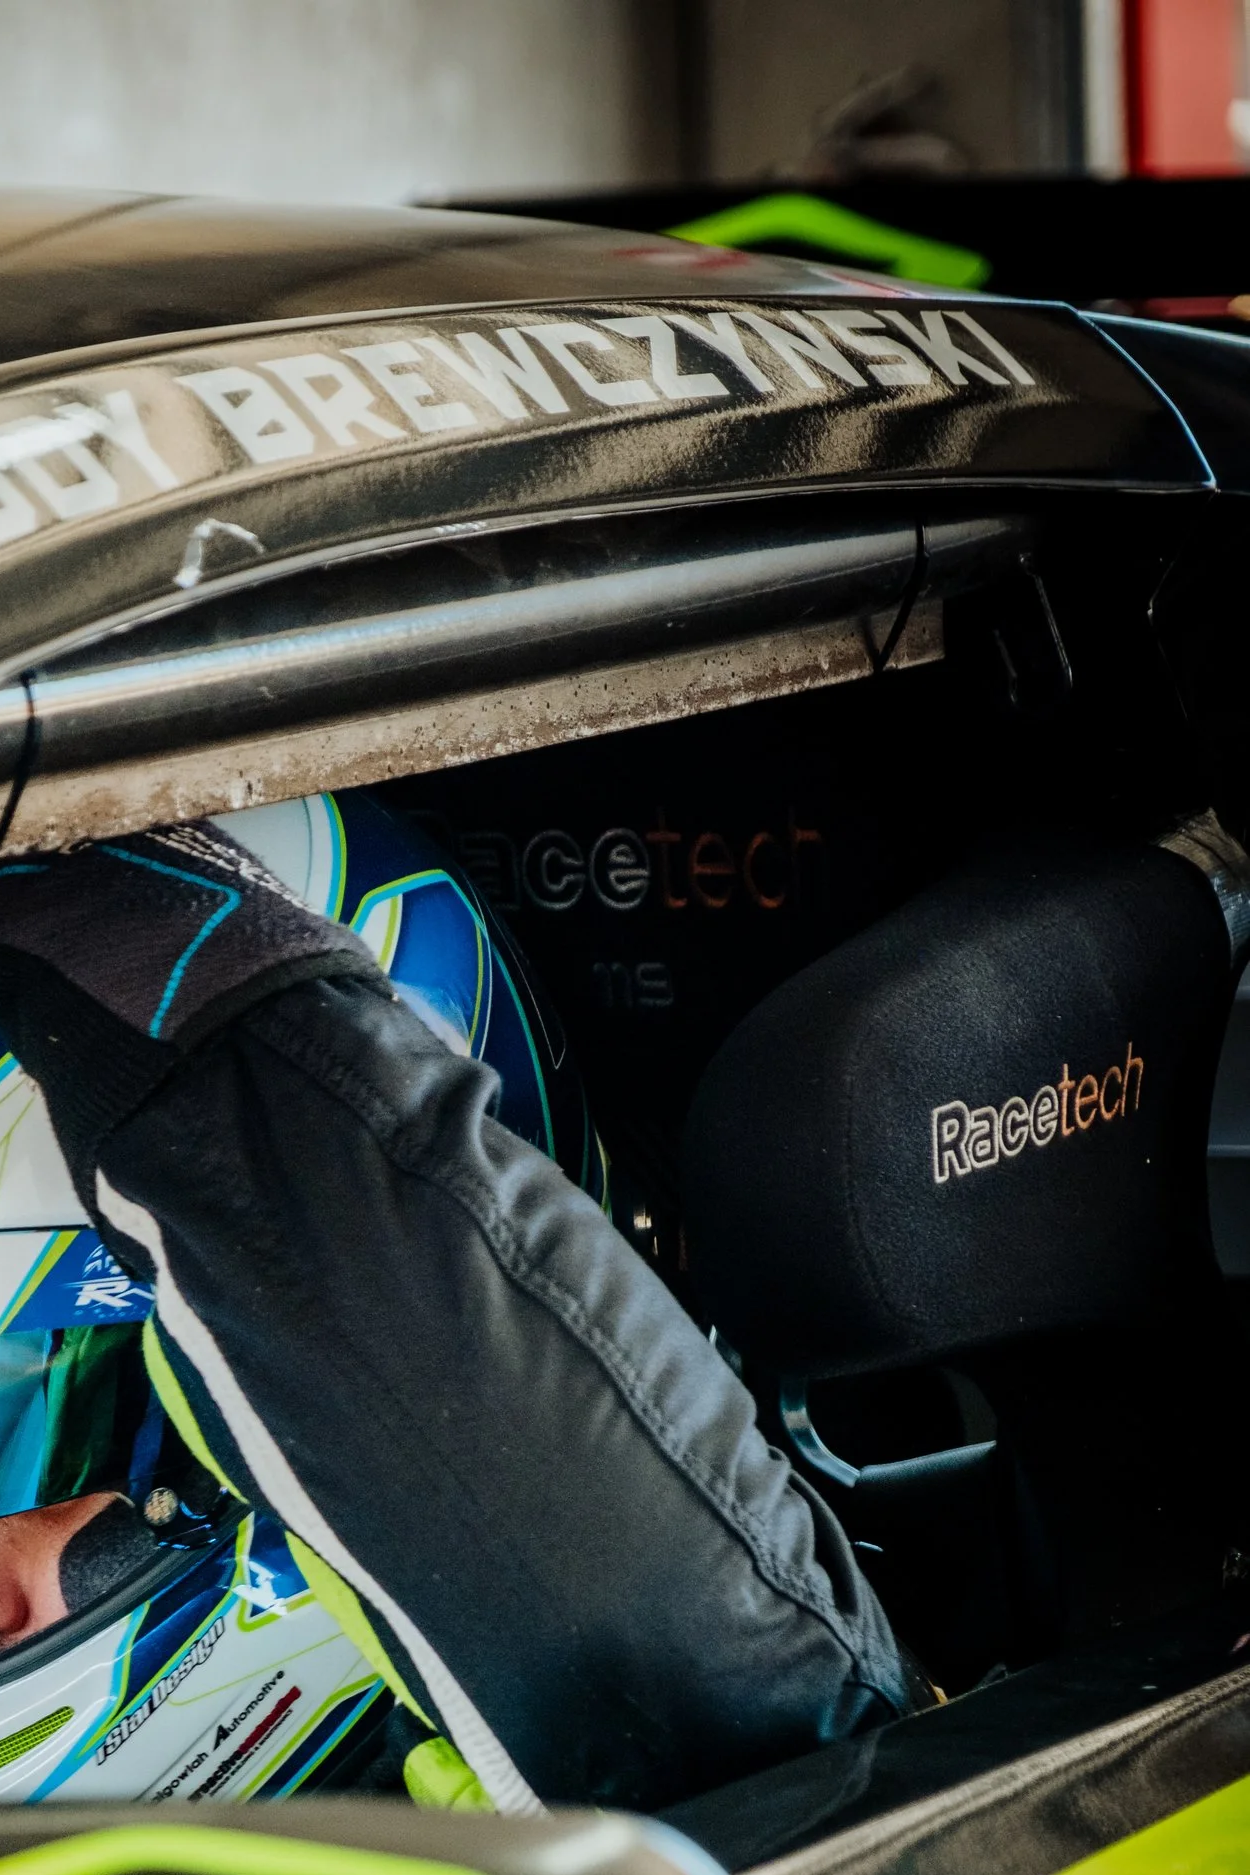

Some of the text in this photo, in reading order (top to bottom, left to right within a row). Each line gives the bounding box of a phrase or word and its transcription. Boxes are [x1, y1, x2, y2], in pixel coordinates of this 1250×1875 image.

[174, 310, 1037, 464] BREWCZYNSKI
[430, 803, 830, 912] acetech
[931, 1041, 1146, 1185] Racetech
[212, 1669, 285, 1752] Automotive
